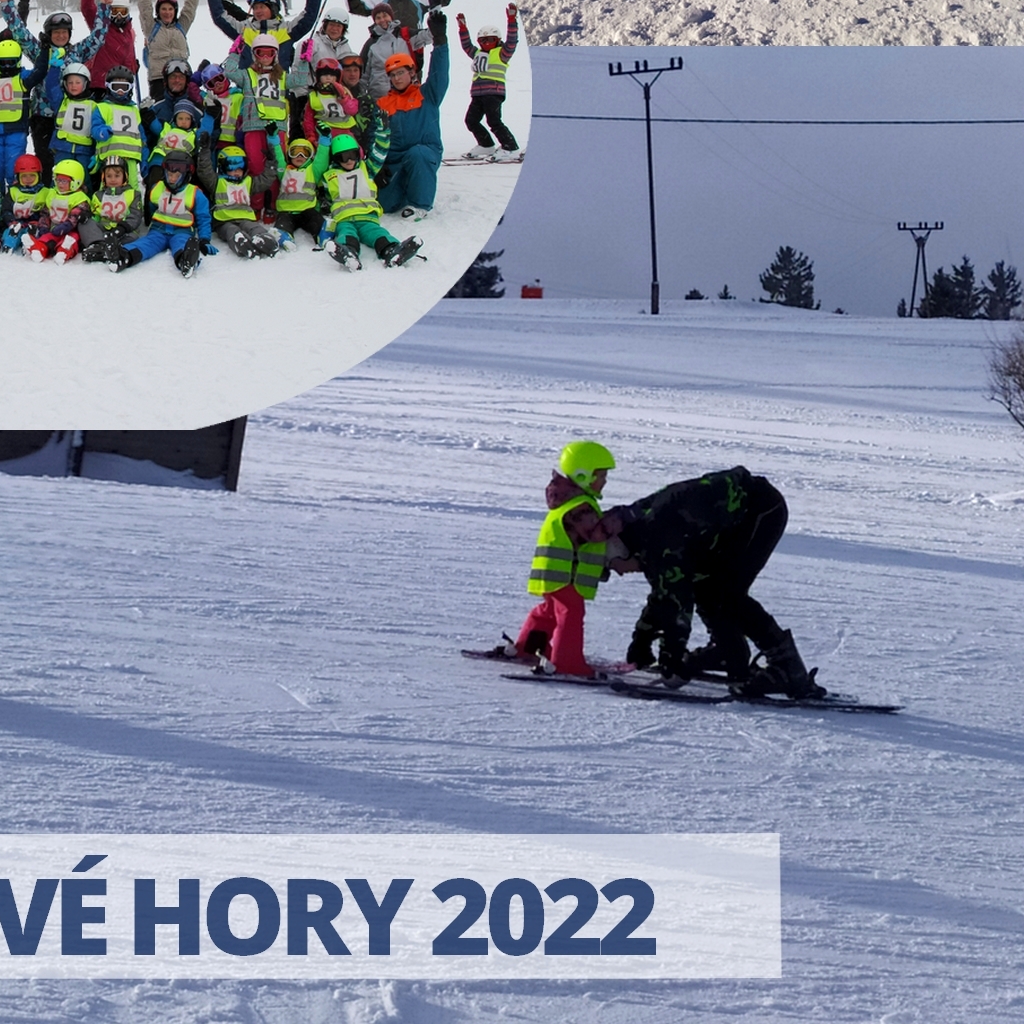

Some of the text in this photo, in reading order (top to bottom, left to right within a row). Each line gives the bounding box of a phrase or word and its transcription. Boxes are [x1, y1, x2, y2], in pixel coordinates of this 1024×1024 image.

[72, 107, 86, 131] 5
[121, 115, 132, 131] 2
[346, 174, 358, 200] 7
[102, 200, 127, 223] 32
[162, 197, 183, 215] 17
